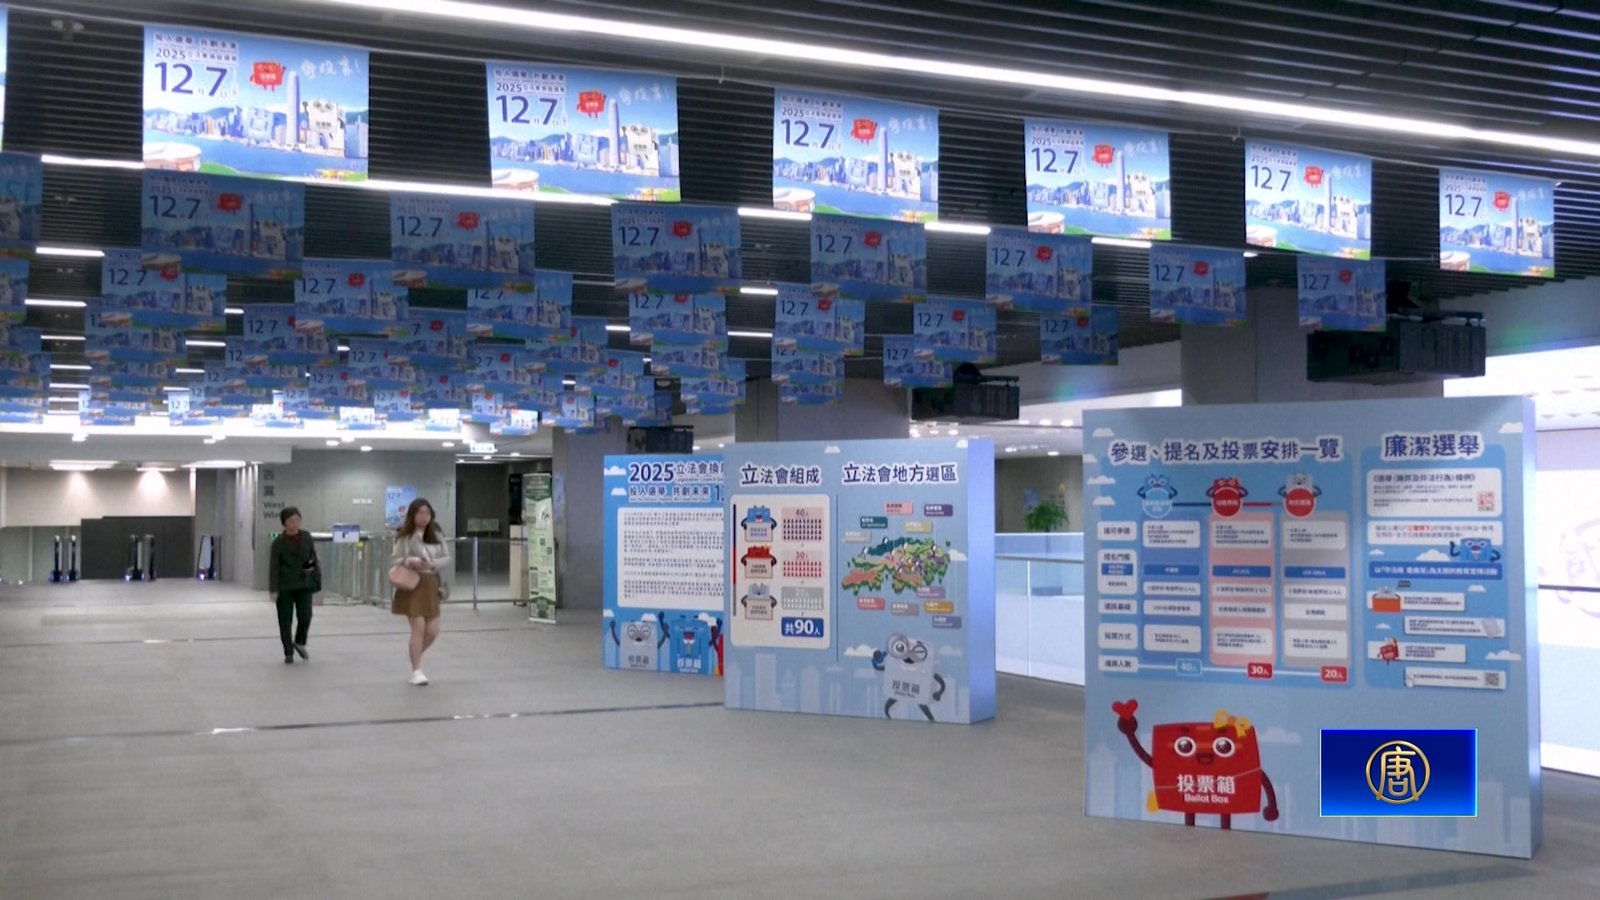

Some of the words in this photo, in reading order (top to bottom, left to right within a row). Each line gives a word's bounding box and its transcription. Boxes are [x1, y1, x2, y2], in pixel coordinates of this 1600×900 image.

[1111, 439, 1341, 463] 參選、提名及投票安排一覽
[1384, 434, 1480, 457] 廉潔選舉
[741, 465, 820, 485] 立法會組成
[843, 463, 957, 483] 立法會地方選區
[784, 619, 820, 635] 共90人
[1177, 774, 1236, 794] 投票箱
[1184, 793, 1209, 803] Ballot
[1211, 794, 1229, 804] Box
